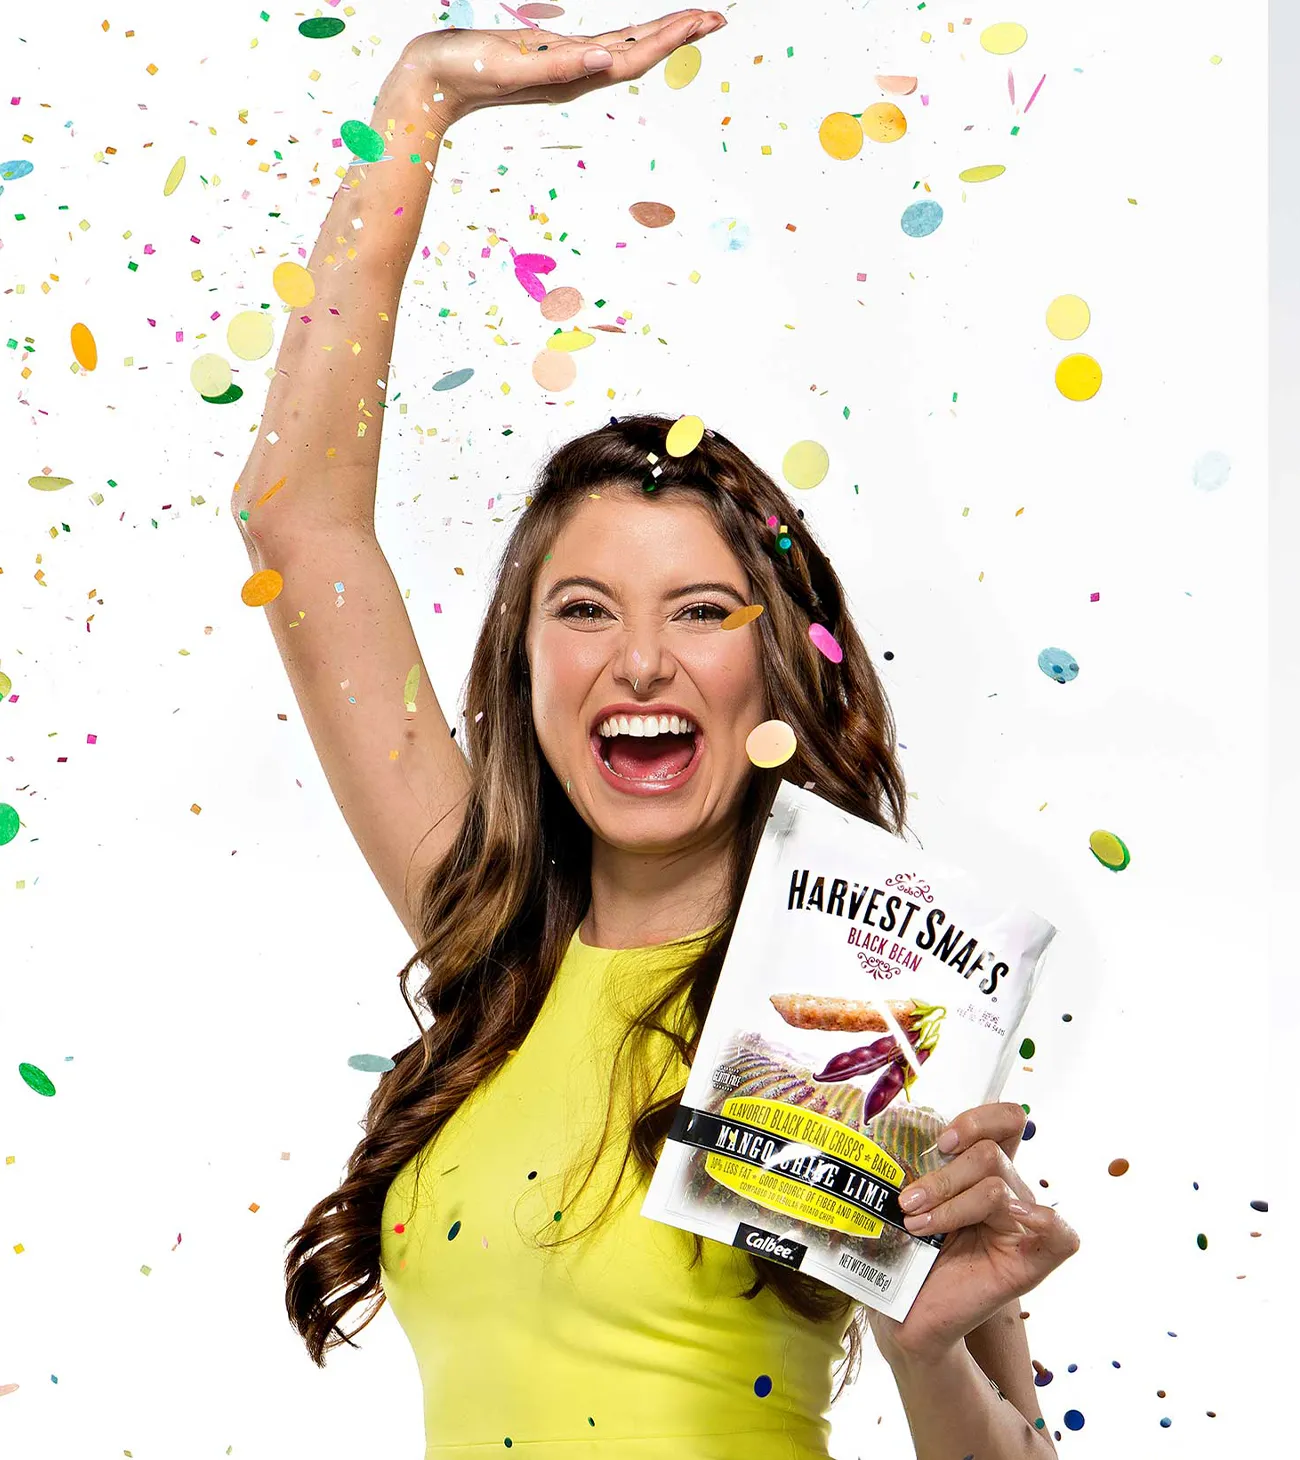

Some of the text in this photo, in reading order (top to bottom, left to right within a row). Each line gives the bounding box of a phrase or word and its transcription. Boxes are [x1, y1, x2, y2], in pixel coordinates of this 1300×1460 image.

[788, 870, 1010, 995] HARVEST SNAPS
[847, 927, 924, 973] BLACK BEAN
[715, 1124, 776, 1163] MANGO
[843, 1172, 890, 1213] LIME
[728, 1103, 898, 1181] FLAVORED BLACK BEAN CRISPS BAKED
[723, 1161, 739, 1176] LESS
[738, 1166, 753, 1180] FAT
[758, 1173, 779, 1190] GOOD
[778, 1181, 806, 1200] SOURCE
[805, 1190, 817, 1202] OF
[815, 1194, 837, 1212] FIBER
[836, 1204, 851, 1219] AND
[851, 1210, 877, 1232] PROTEIN
[739, 1181, 767, 1198] COMPARED
[799, 1202, 819, 1217] POTATO
[818, 1211, 836, 1225] CHIPS
[838, 1253, 853, 1269] NET
[850, 1258, 863, 1274] WT
[866, 1267, 879, 1283] OZ
